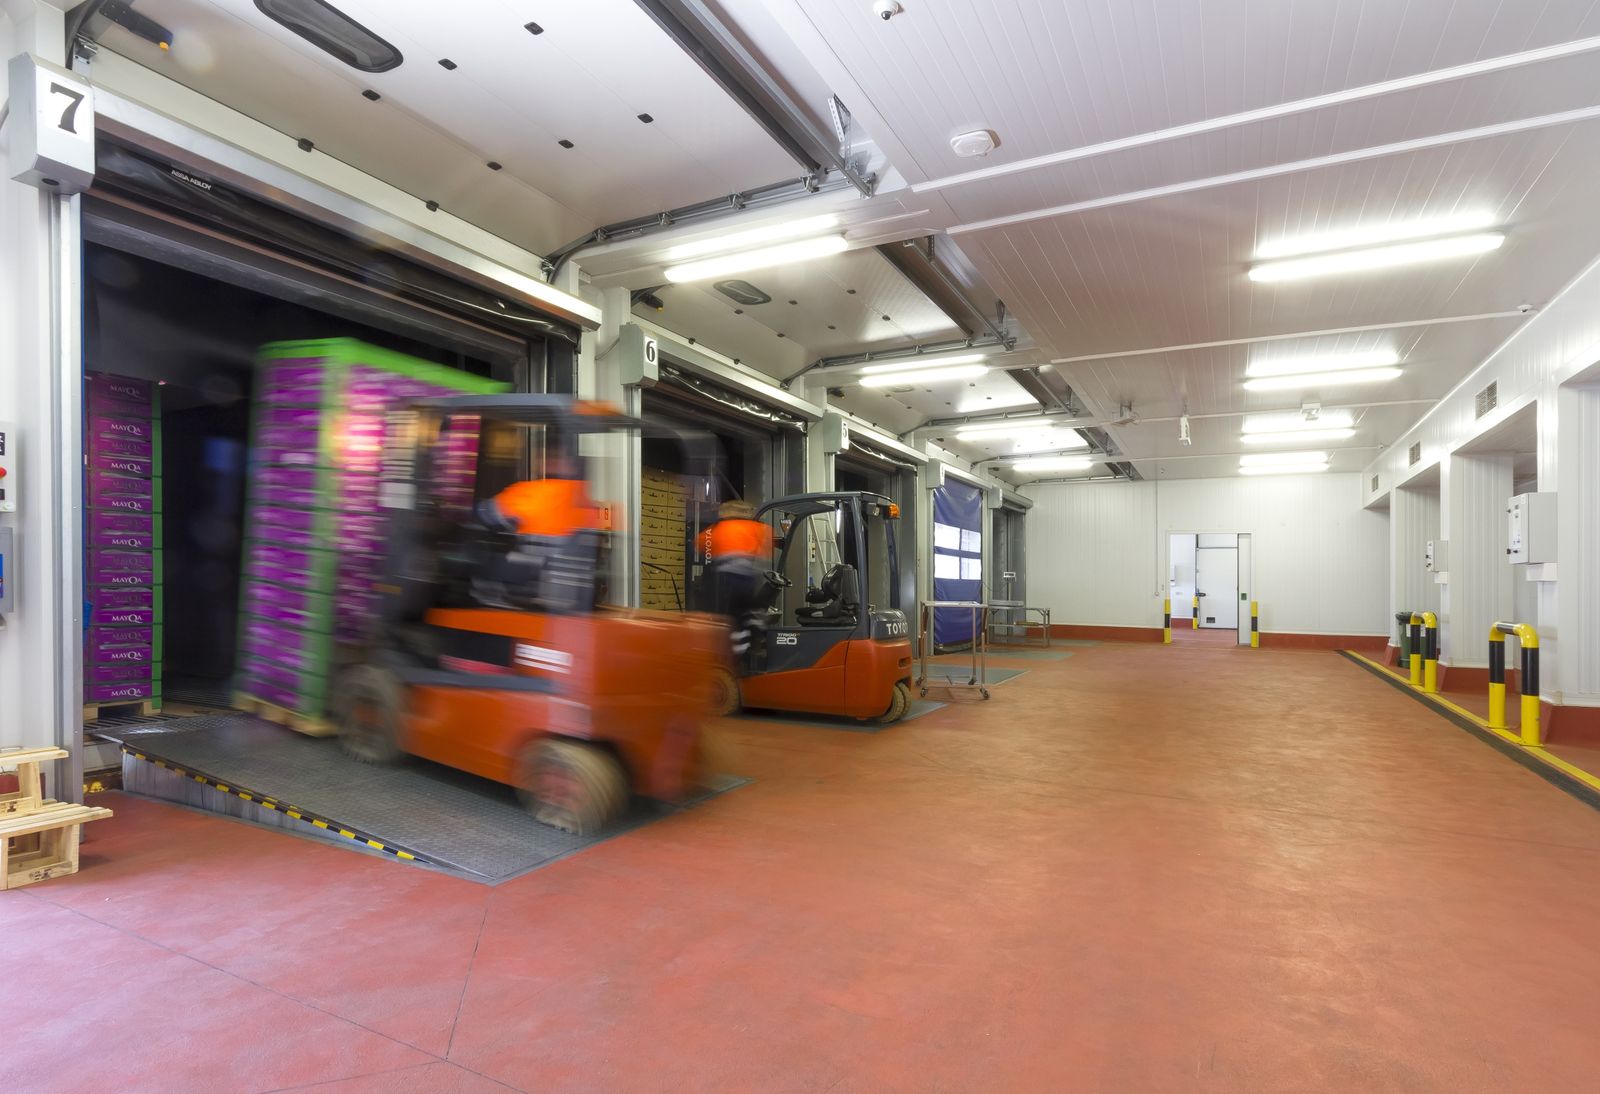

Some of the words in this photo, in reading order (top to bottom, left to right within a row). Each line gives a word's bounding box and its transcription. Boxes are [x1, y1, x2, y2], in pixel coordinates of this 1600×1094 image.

[50, 82, 85, 135] 7
[646, 341, 656, 362] 6
[111, 424, 143, 435] MAYQA
[843, 422, 848, 438] 5
[111, 463, 143, 473] MAYQA
[111, 501, 143, 511] MAYQA
[112, 539, 142, 548] MAYQA
[112, 576, 143, 585] MAYQA
[112, 614, 143, 624] MAYQA
[886, 622, 909, 635] TOYO
[776, 636, 798, 645] 20
[111, 651, 143, 661] MAYQA
[111, 688, 143, 697] MAYQA
